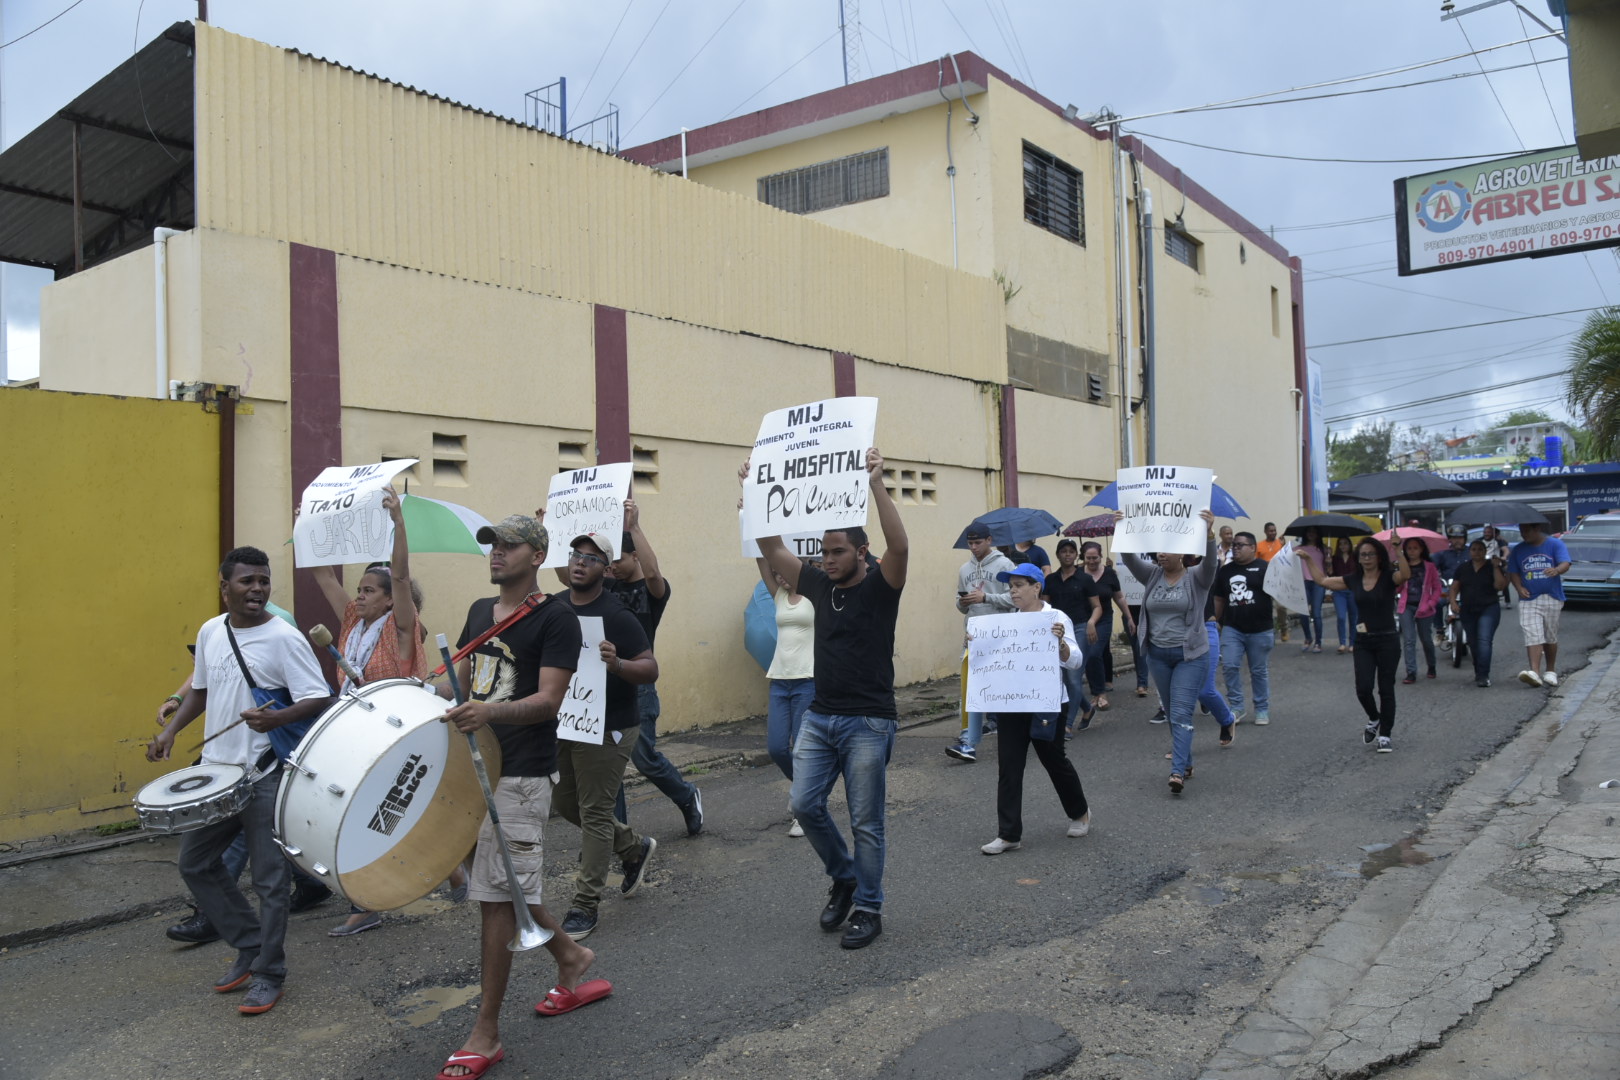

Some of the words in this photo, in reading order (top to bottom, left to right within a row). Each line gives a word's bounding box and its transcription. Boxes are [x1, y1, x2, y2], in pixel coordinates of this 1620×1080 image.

[1472, 179, 1587, 226] ABREU
[1424, 231, 1488, 252] PRODUCTOS
[1490, 218, 1568, 241] VETERINARIOS
[1569, 216, 1580, 228] Y
[1438, 238, 1534, 265] 809-970-4901
[1550, 224, 1620, 247] 809-970-
[787, 403, 824, 427] MIJ
[809, 420, 853, 434] INTEGRAL
[785, 438, 820, 452] JUVENIL
[349, 464, 381, 479] MIJ
[757, 463, 775, 485] EL
[783, 449, 865, 481] HOSPITAL
[1145, 467, 1176, 480] MIJ
[1511, 465, 1571, 478] RIVERA
[571, 468, 597, 485] MIJ
[586, 482, 614, 492] INTEGRAL
[1117, 483, 1150, 491] MOVIMIENTO
[1163, 482, 1199, 491] INTEGRAL
[310, 493, 355, 514] TAMO
[555, 496, 619, 519] CORAAMOCA
[1524, 561, 1552, 570] Gallina
[1528, 555, 1546, 563] Doña
